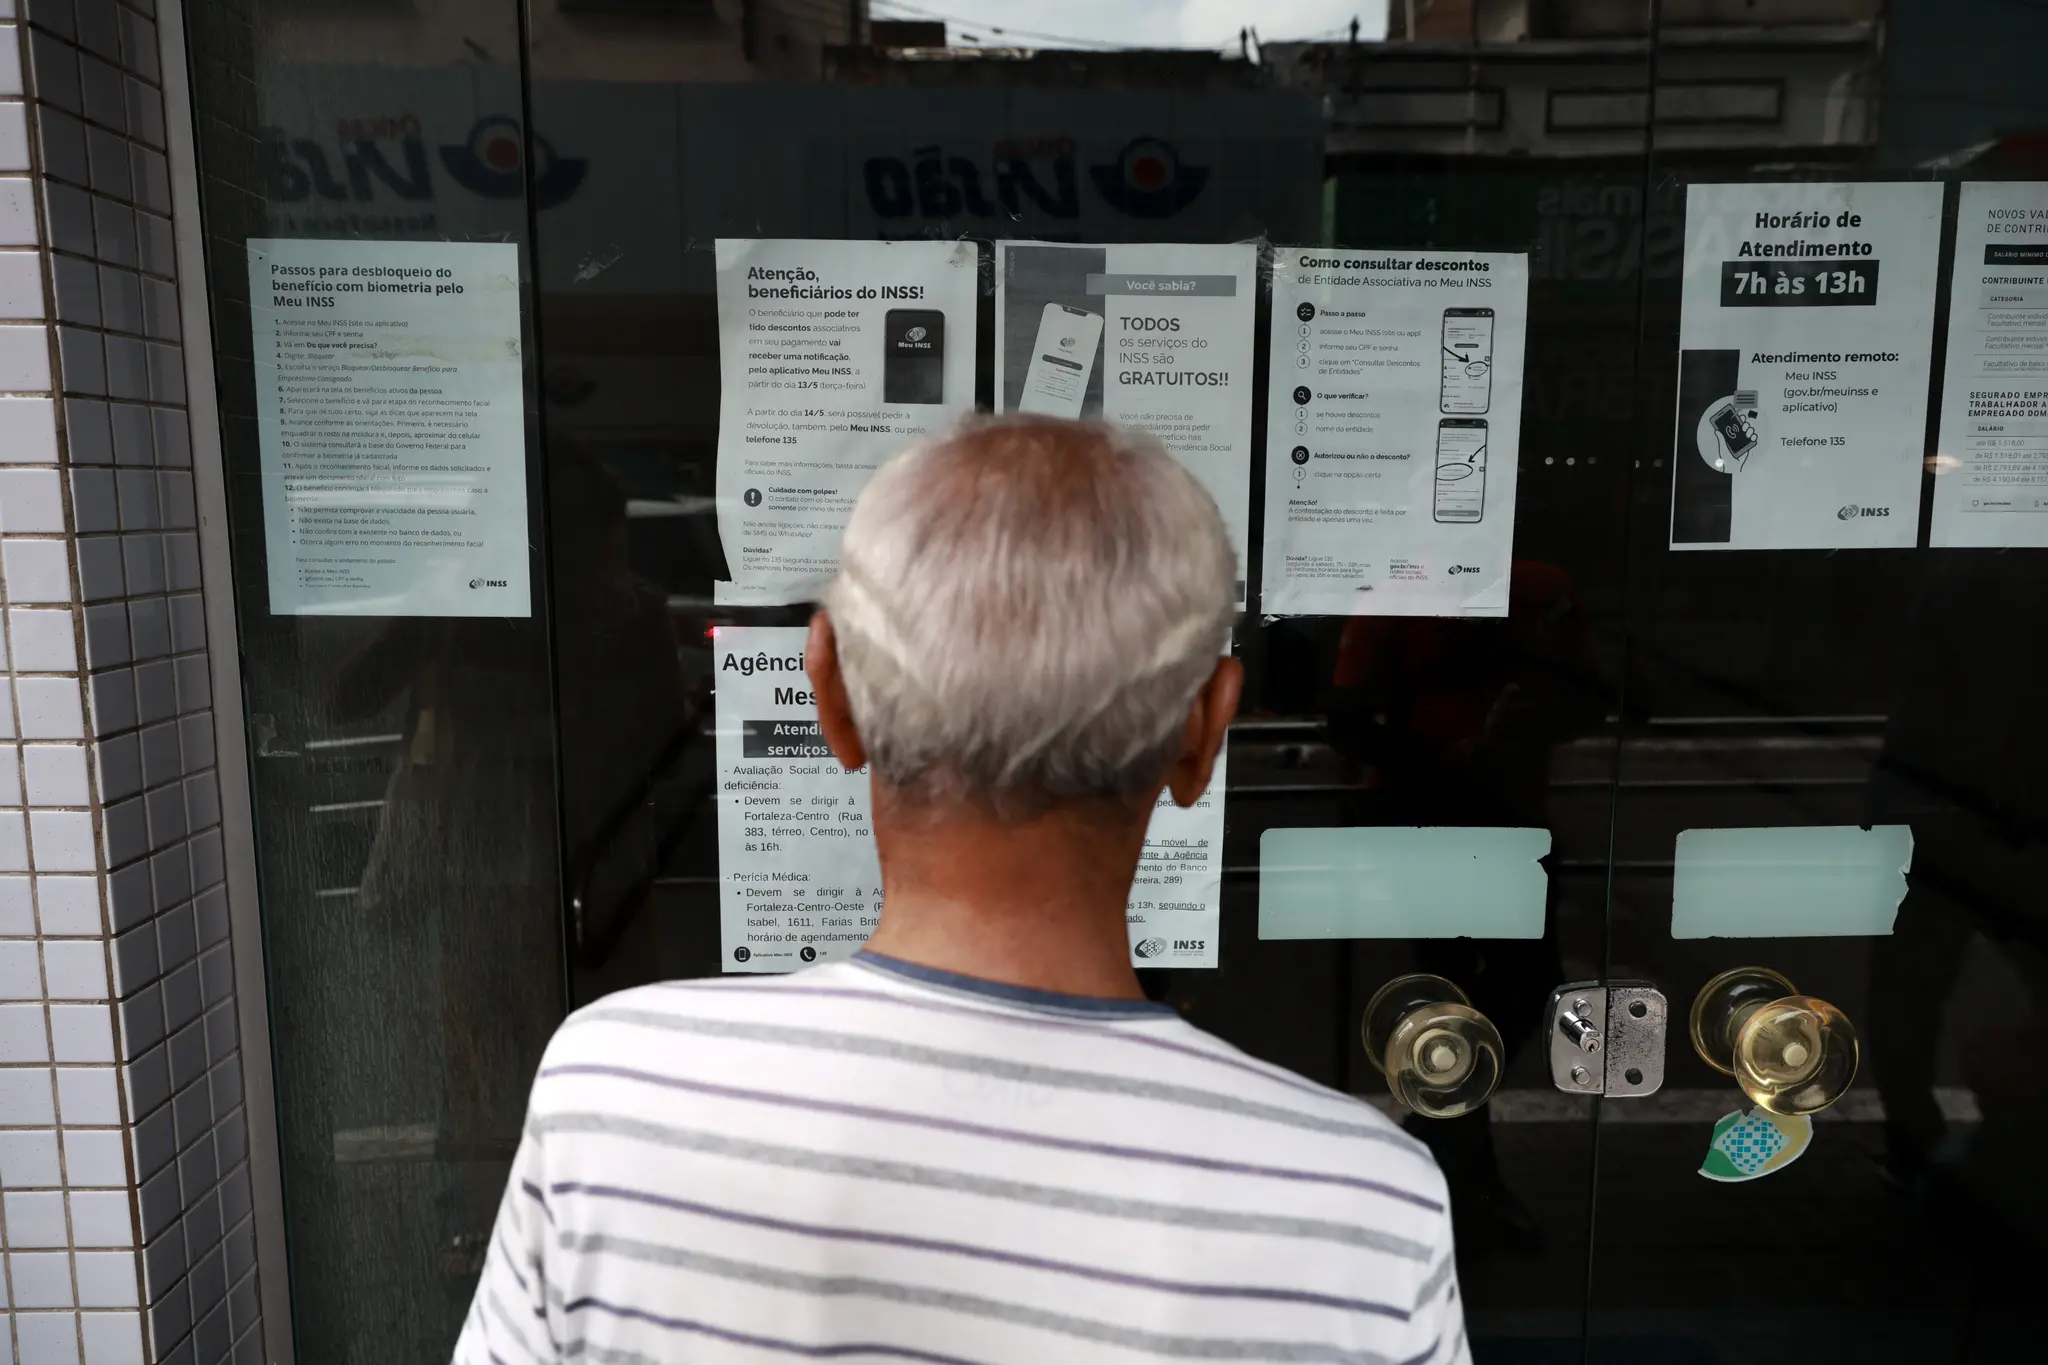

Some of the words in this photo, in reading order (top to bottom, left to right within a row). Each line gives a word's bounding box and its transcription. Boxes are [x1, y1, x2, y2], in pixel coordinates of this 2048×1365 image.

[1988, 209, 2025, 219] NOVOS
[1755, 211, 1830, 228] Horário
[1836, 211, 1862, 228] de
[1987, 224, 2001, 233] DE
[1738, 240, 1873, 257] Atendimento
[1299, 256, 1341, 269] Como
[1344, 258, 1412, 270] consultar
[1415, 259, 1489, 272] descontos
[271, 264, 316, 276] Passos
[319, 267, 348, 280] para
[352, 266, 432, 280] desbloqueio
[436, 267, 452, 277] do
[748, 267, 820, 283] Atenção,
[1127, 280, 1155, 290] Você
[1159, 280, 1196, 291] sabia?
[1298, 275, 1311, 284] de
[1314, 276, 1360, 286] Entidade
[1363, 277, 1421, 287] Associativa
[1440, 278, 1463, 288] Meu
[1466, 278, 1492, 288] INSS
[1734, 272, 1767, 294] 7h
[1774, 271, 1805, 294] às
[1815, 270, 1865, 294] 13h
[272, 280, 333, 292] benefício
[336, 283, 364, 292] com
[367, 282, 432, 293] biometria
[436, 283, 463, 297] pelo
[748, 284, 852, 299] beneficiários
[856, 285, 877, 299] do
[881, 286, 924, 299] INSS!
[273, 296, 302, 307] Meu
[306, 297, 335, 308] INSS
[749, 309, 756, 317] O
[758, 309, 804, 318] beneficiário
[806, 311, 822, 319] que
[824, 311, 846, 319] pode
[749, 323, 766, 331] tido
[768, 324, 811, 332] descontos
[813, 324, 861, 332] associativos
[1120, 317, 1180, 332] TODOS
[781, 339, 827, 348] pagamento
[1120, 338, 1134, 347] os
[1137, 337, 1188, 349] serviços
[1191, 337, 1208, 348] do
[749, 352, 781, 360] receber
[804, 352, 851, 363] notificação,
[1120, 353, 1149, 364] INSS
[1153, 353, 1175, 364] são
[1751, 352, 1841, 364] Atendimento
[1845, 352, 1899, 362] remoto:
[749, 366, 767, 375] pelo
[769, 367, 810, 376] aplicativo
[1785, 371, 1810, 381] Meu
[1812, 371, 1837, 380] INSS
[1119, 372, 1228, 386] GRATUITOS!!
[748, 381, 769, 389] partir
[771, 381, 782, 389] do
[784, 381, 796, 389] dia
[798, 381, 818, 389] 13/5
[1783, 387, 1868, 398] (gov.br/meuinss
[1871, 388, 1878, 396] e
[1782, 402, 1837, 413] aplicativo)
[1140, 413, 1154, 421] não
[746, 436, 780, 444] telefone
[1781, 436, 1827, 446] Telefone
[1830, 437, 1845, 446] 135
[1209, 444, 1232, 452] Social
[1861, 507, 1890, 517] INSS
[723, 652, 803, 676] Agênci
[768, 743, 828, 758] serviços
[734, 766, 783, 777] Avaliação
[789, 766, 820, 774] Social
[826, 766, 838, 774] do
[725, 781, 782, 790] deficiência:
[745, 797, 780, 805] Devem
[811, 796, 839, 808] dirigir
[848, 797, 855, 805] à
[745, 812, 829, 821] Fortaleza-Centro
[838, 812, 863, 823] (Rua
[745, 828, 767, 838] 383,
[772, 828, 805, 838] térreo,
[810, 828, 850, 838] Centro),
[745, 843, 757, 852] às
[761, 843, 782, 852] 16h.
[1162, 839, 1187, 847] móvel
[1198, 839, 1208, 847] de
[1164, 851, 1169, 859] à
[1174, 851, 1208, 860] Agência
[1180, 864, 1207, 872] Banco
[734, 872, 769, 882] Perícia
[772, 873, 811, 882] Médica:
[1164, 876, 1183, 885] 289)
[747, 903, 864, 912] Fortaleza-Centro-Oeste
[1138, 901, 1156, 910] 13h,
[1159, 902, 1197, 911] seguindo
[748, 918, 780, 928] Isabel,
[788, 918, 814, 928] 1611,
[822, 918, 853, 926] Farias
[748, 933, 782, 942] horário
[785, 933, 798, 942] de
[1173, 940, 1205, 950] INSS
